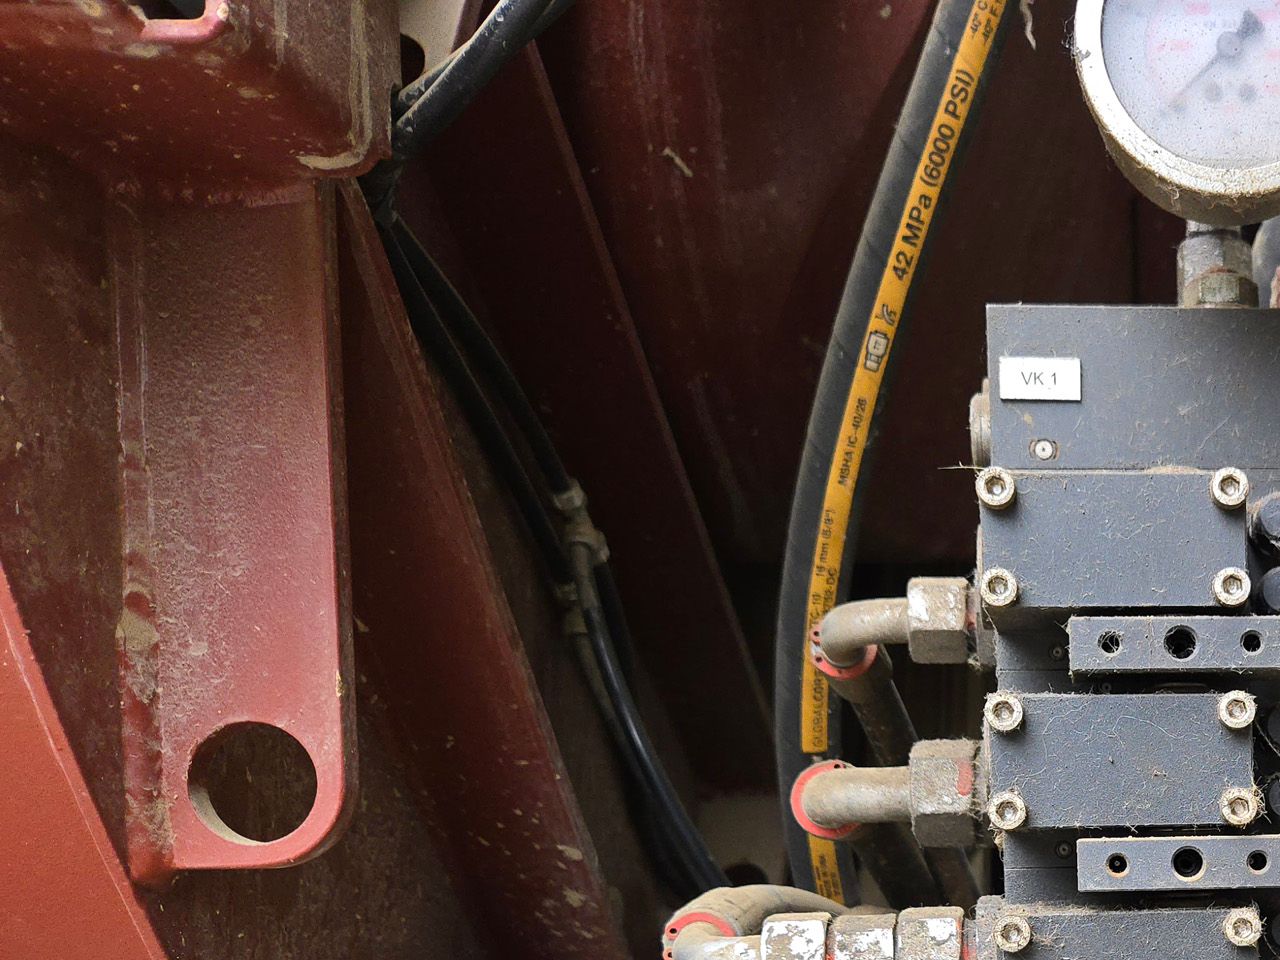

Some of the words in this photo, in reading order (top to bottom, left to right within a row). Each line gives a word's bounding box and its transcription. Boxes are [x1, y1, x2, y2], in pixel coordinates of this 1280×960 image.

[944, 69, 975, 121] PSI)
[920, 123, 955, 187] (6000
[902, 193, 932, 248] MPa
[892, 251, 914, 281] 42
[1021, 372, 1044, 386] VK
[1051, 372, 1057, 386] 1
